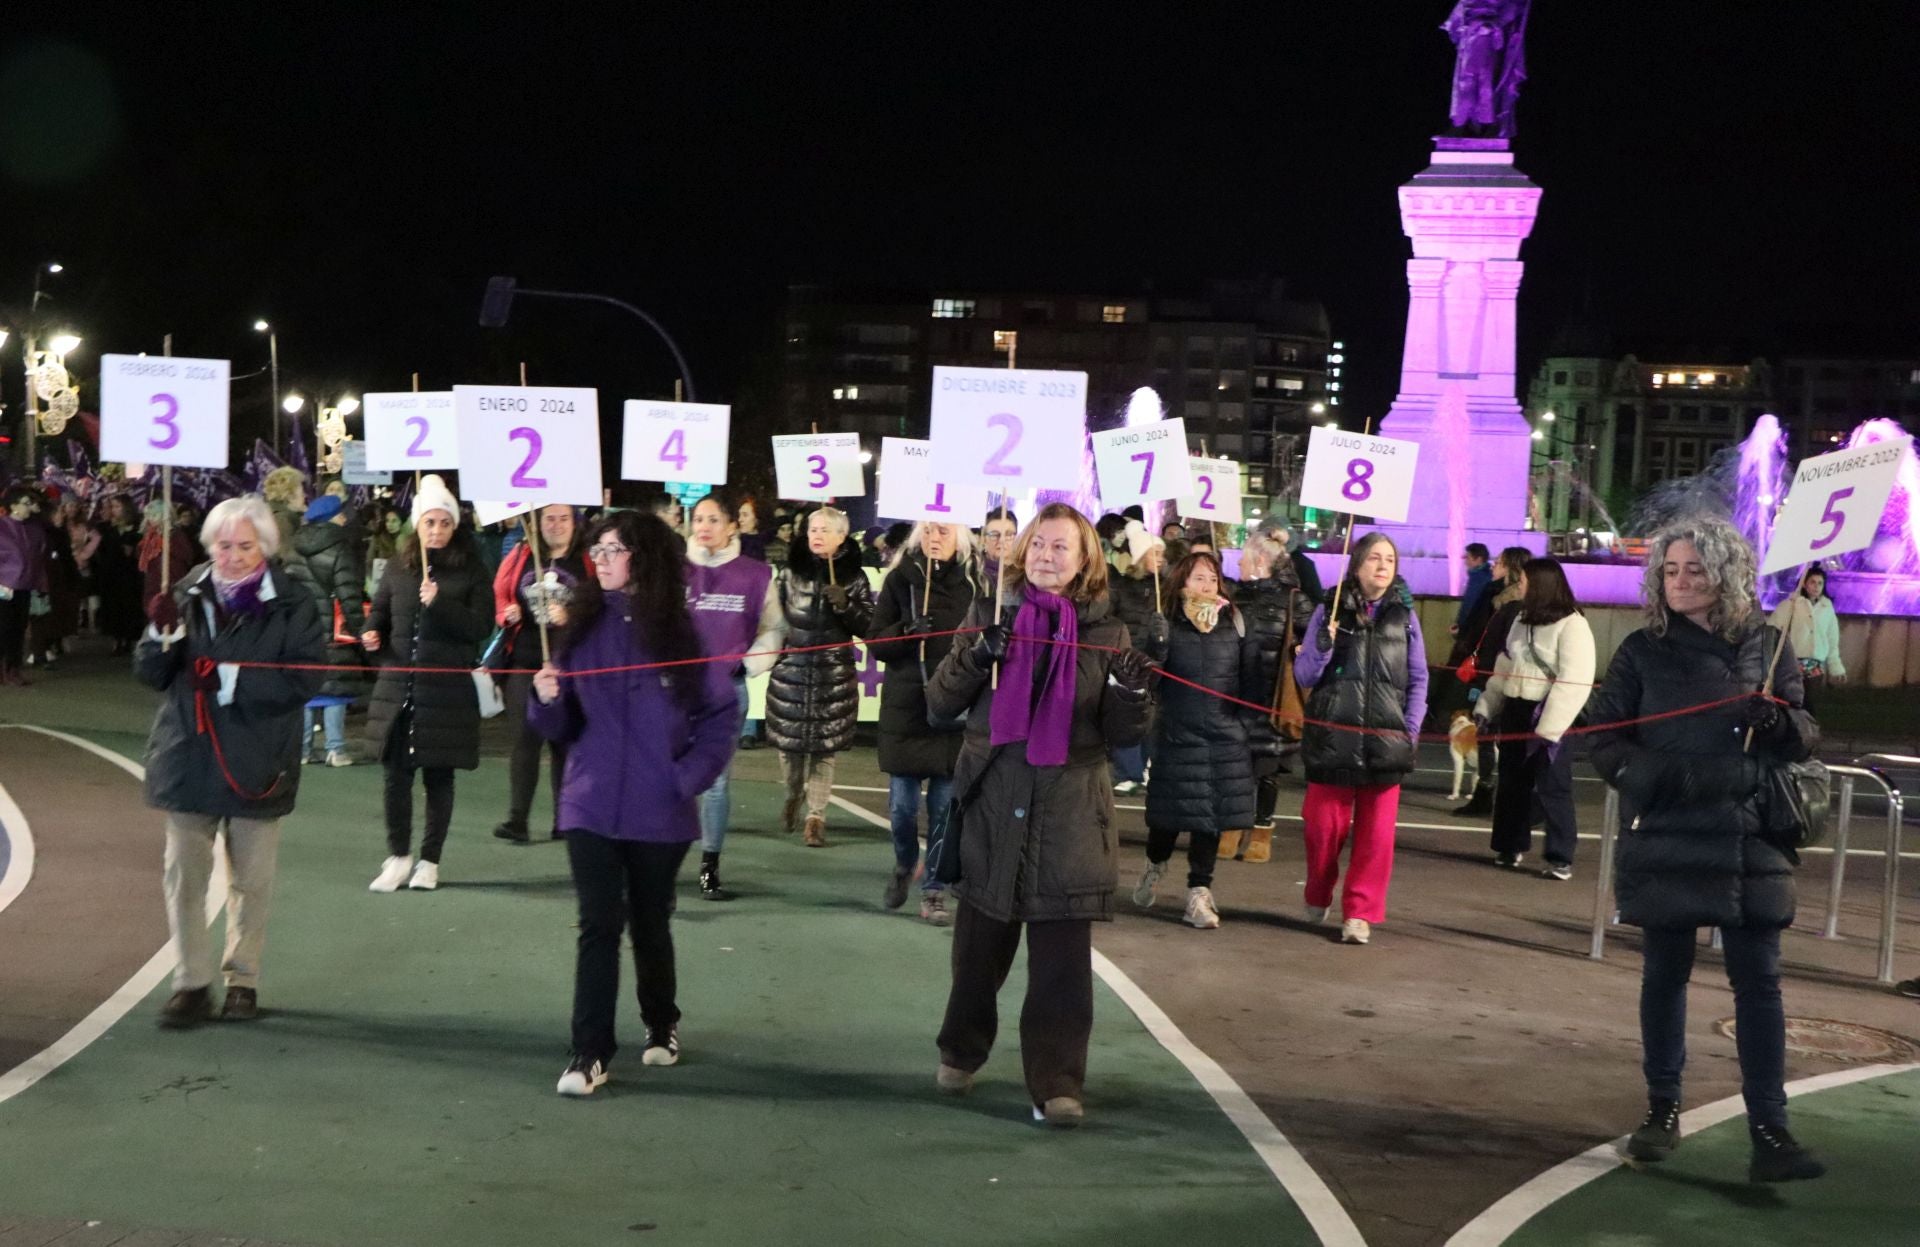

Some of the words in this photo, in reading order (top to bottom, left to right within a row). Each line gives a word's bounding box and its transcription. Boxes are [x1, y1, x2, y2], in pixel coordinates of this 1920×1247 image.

[120, 362, 179, 378] FEBRERO
[184, 366, 217, 381] 2024
[942, 376, 1027, 395] DICIEMBRE
[1039, 382, 1077, 398] 2023
[148, 392, 181, 450] 3
[479, 397, 528, 412] ENERO
[540, 398, 575, 413] 2024
[405, 416, 433, 457] 2
[659, 429, 688, 471] 4
[776, 438, 829, 448] SEPTIEMBRE
[903, 446, 930, 457] MAY
[982, 412, 1024, 476] 2
[1111, 433, 1139, 447] JUNIO
[1146, 429, 1168, 442] 2024
[1330, 435, 1362, 451] JULIO
[1369, 441, 1396, 456] 2024
[508, 426, 548, 488] 2
[806, 454, 830, 489] 3
[1131, 451, 1154, 494] 7
[1798, 454, 1869, 483] NOVIEMBRE
[1869, 447, 1900, 466] 2023
[1198, 475, 1216, 510] 2
[1341, 457, 1374, 502] 8
[1810, 486, 1855, 550] 5
